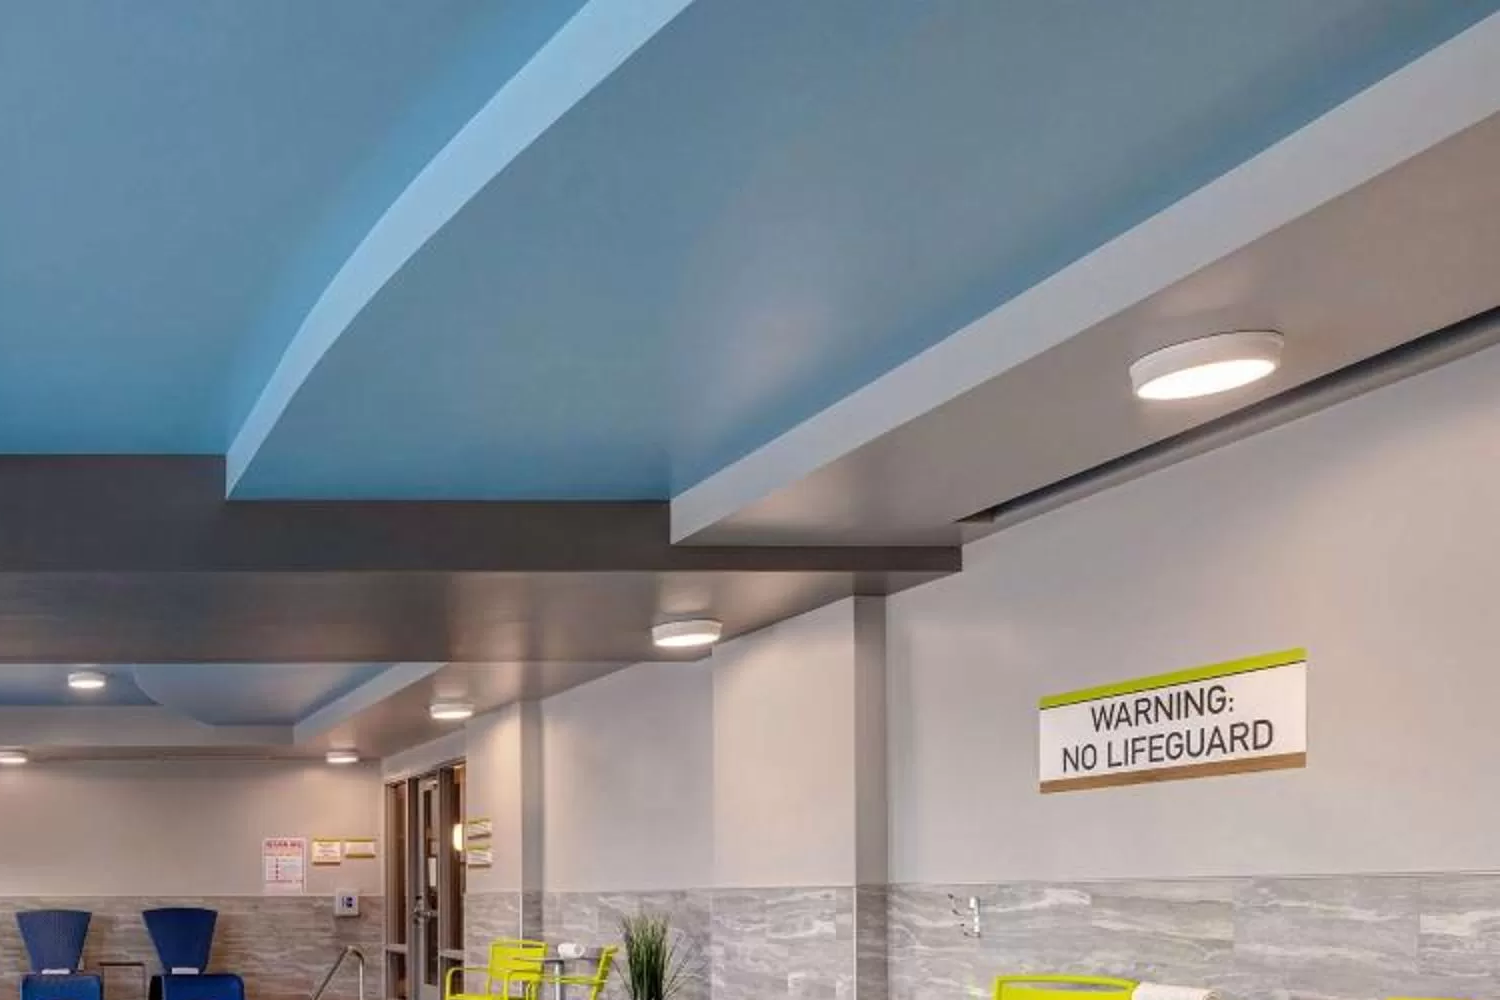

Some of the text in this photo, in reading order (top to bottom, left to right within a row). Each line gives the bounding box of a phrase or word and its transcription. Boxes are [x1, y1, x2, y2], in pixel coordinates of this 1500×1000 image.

[1091, 685, 1234, 732] WARNING:
[1062, 719, 1275, 772] NO LIFEGUARD
